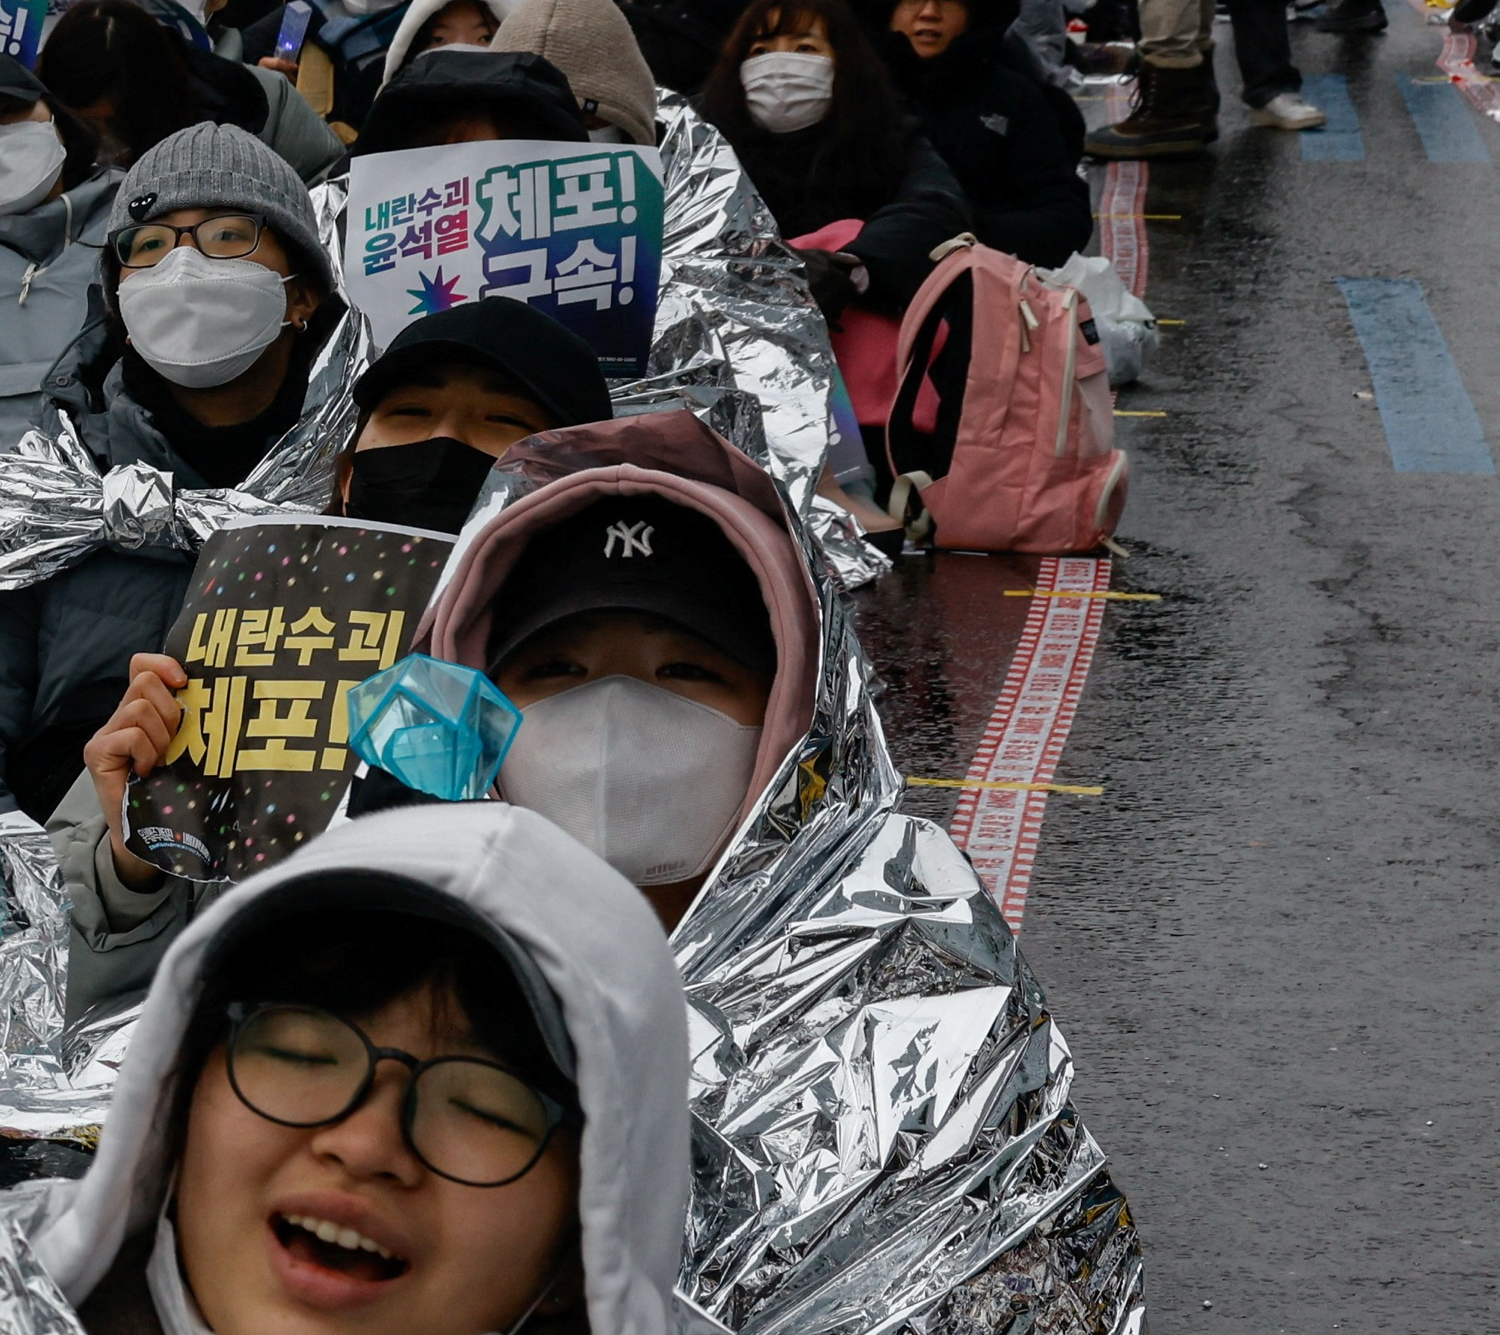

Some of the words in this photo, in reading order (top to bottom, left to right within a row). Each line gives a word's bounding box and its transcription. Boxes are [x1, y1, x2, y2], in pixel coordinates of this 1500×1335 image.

[363, 175, 471, 236] 내란수괴
[473, 153, 640, 244] 체포!
[362, 207, 471, 279] 윤석열
[604, 520, 656, 558] NY
[186, 605, 406, 673] 내란수괴
[165, 675, 360, 780] 체포!
